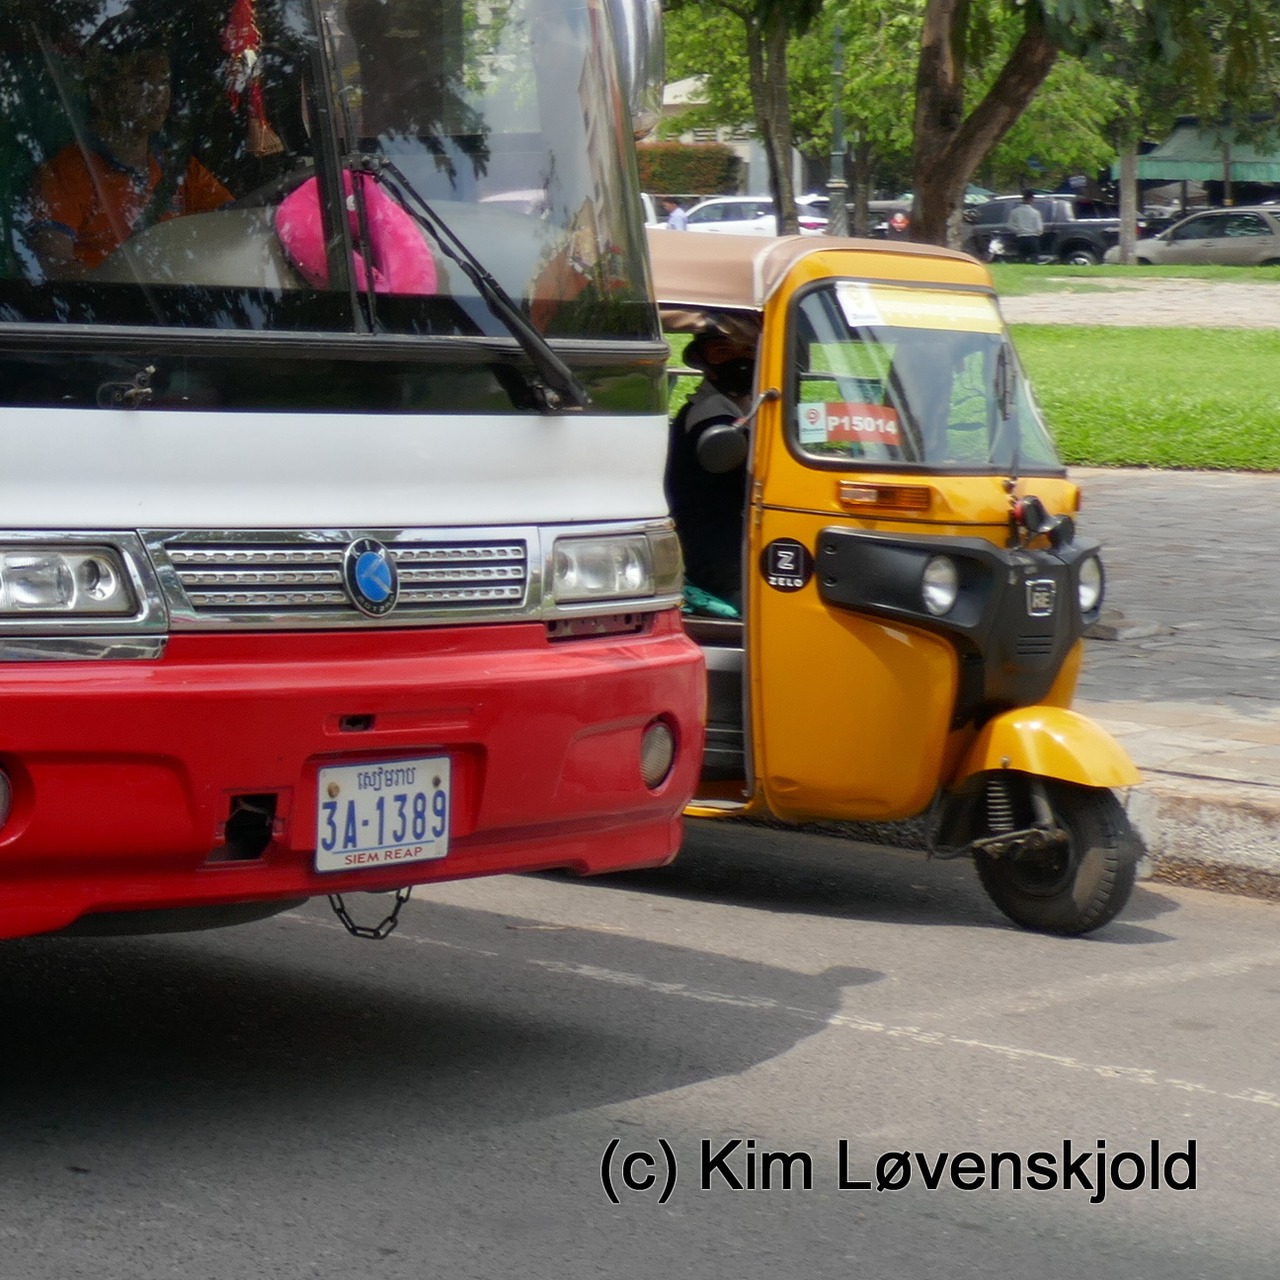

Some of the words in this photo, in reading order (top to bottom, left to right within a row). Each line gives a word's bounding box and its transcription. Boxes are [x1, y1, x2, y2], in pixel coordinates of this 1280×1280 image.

[827, 415, 898, 435] P15014
[768, 576, 804, 588] ZELO
[356, 766, 417, 791] សៀមរាប
[320, 789, 447, 852] 3A-1389
[344, 852, 380, 866] SIEM
[384, 846, 424, 861] REAP
